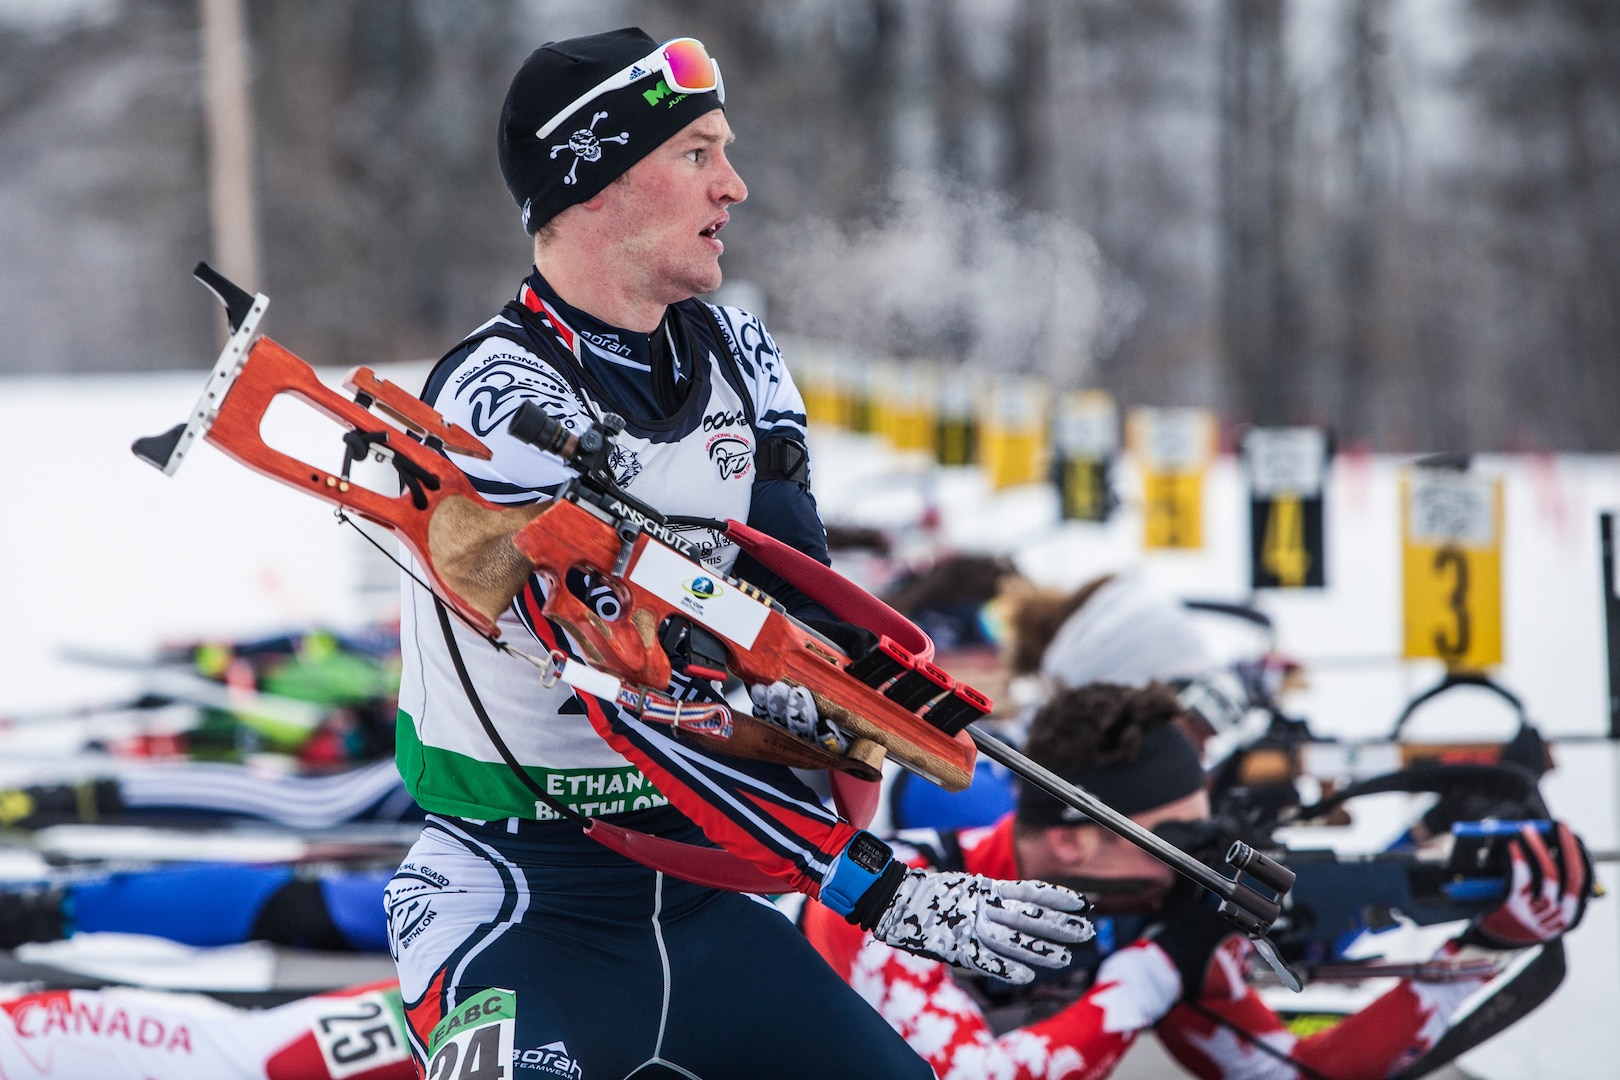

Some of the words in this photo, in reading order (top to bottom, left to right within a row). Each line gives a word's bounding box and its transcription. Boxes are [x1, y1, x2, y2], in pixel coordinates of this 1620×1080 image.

[455, 366, 481, 384] USA
[482, 353, 547, 371] NATIONAL
[709, 433, 732, 442] NATIONAL
[1432, 545, 1471, 657] 3
[546, 770, 645, 797] ETHAN
[420, 866, 450, 887] GUARD
[14, 998, 193, 1057] CANADA
[319, 1002, 398, 1067] 25
[433, 996, 502, 1047] EABC
[429, 1024, 504, 1080] 24
[514, 1063, 573, 1080] TEAMWEAR
